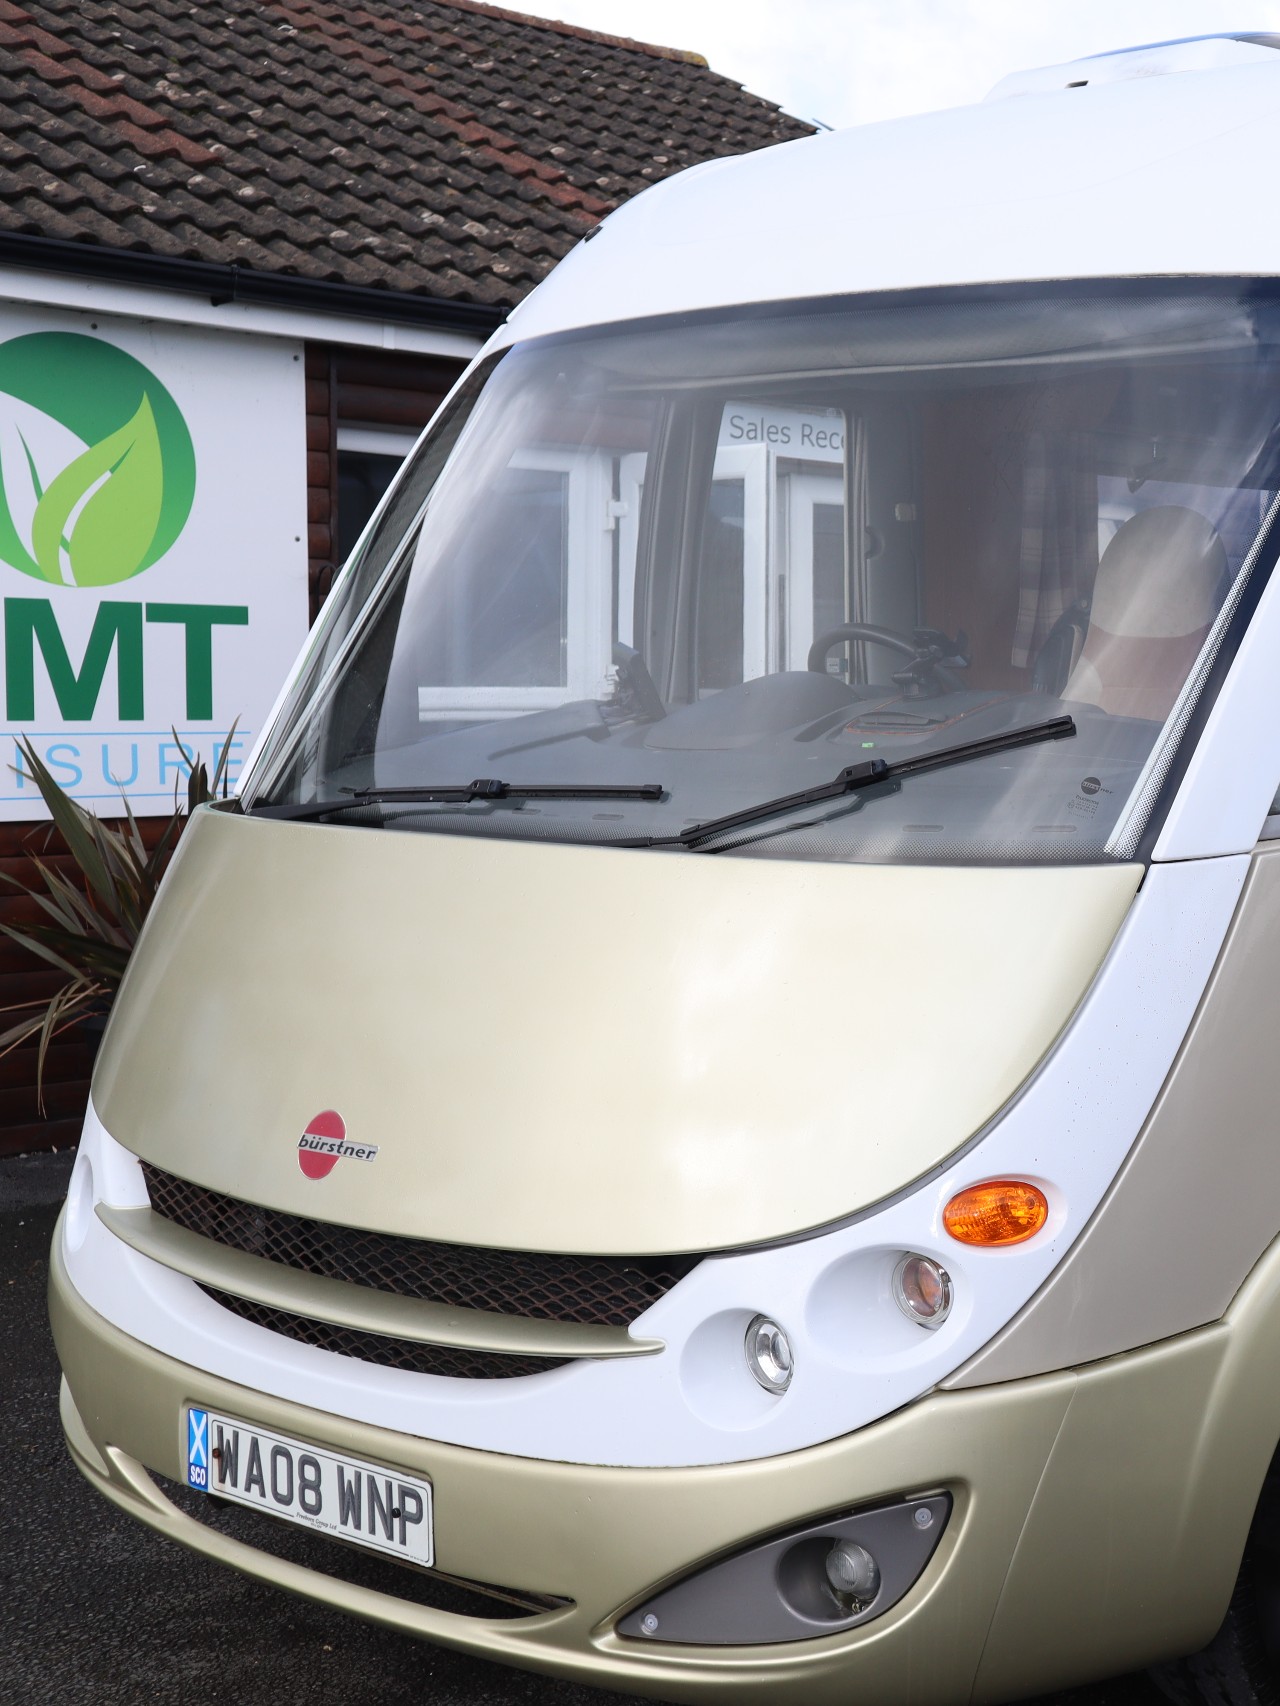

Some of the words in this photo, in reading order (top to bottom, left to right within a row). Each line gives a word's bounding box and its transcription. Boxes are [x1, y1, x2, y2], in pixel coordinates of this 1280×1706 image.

[729, 415, 792, 444] Sales
[298, 1134, 377, 1160] bürstner
[190, 1464, 206, 1486] SCO
[216, 1425, 323, 1517] WA08
[336, 1464, 424, 1547] WNP
